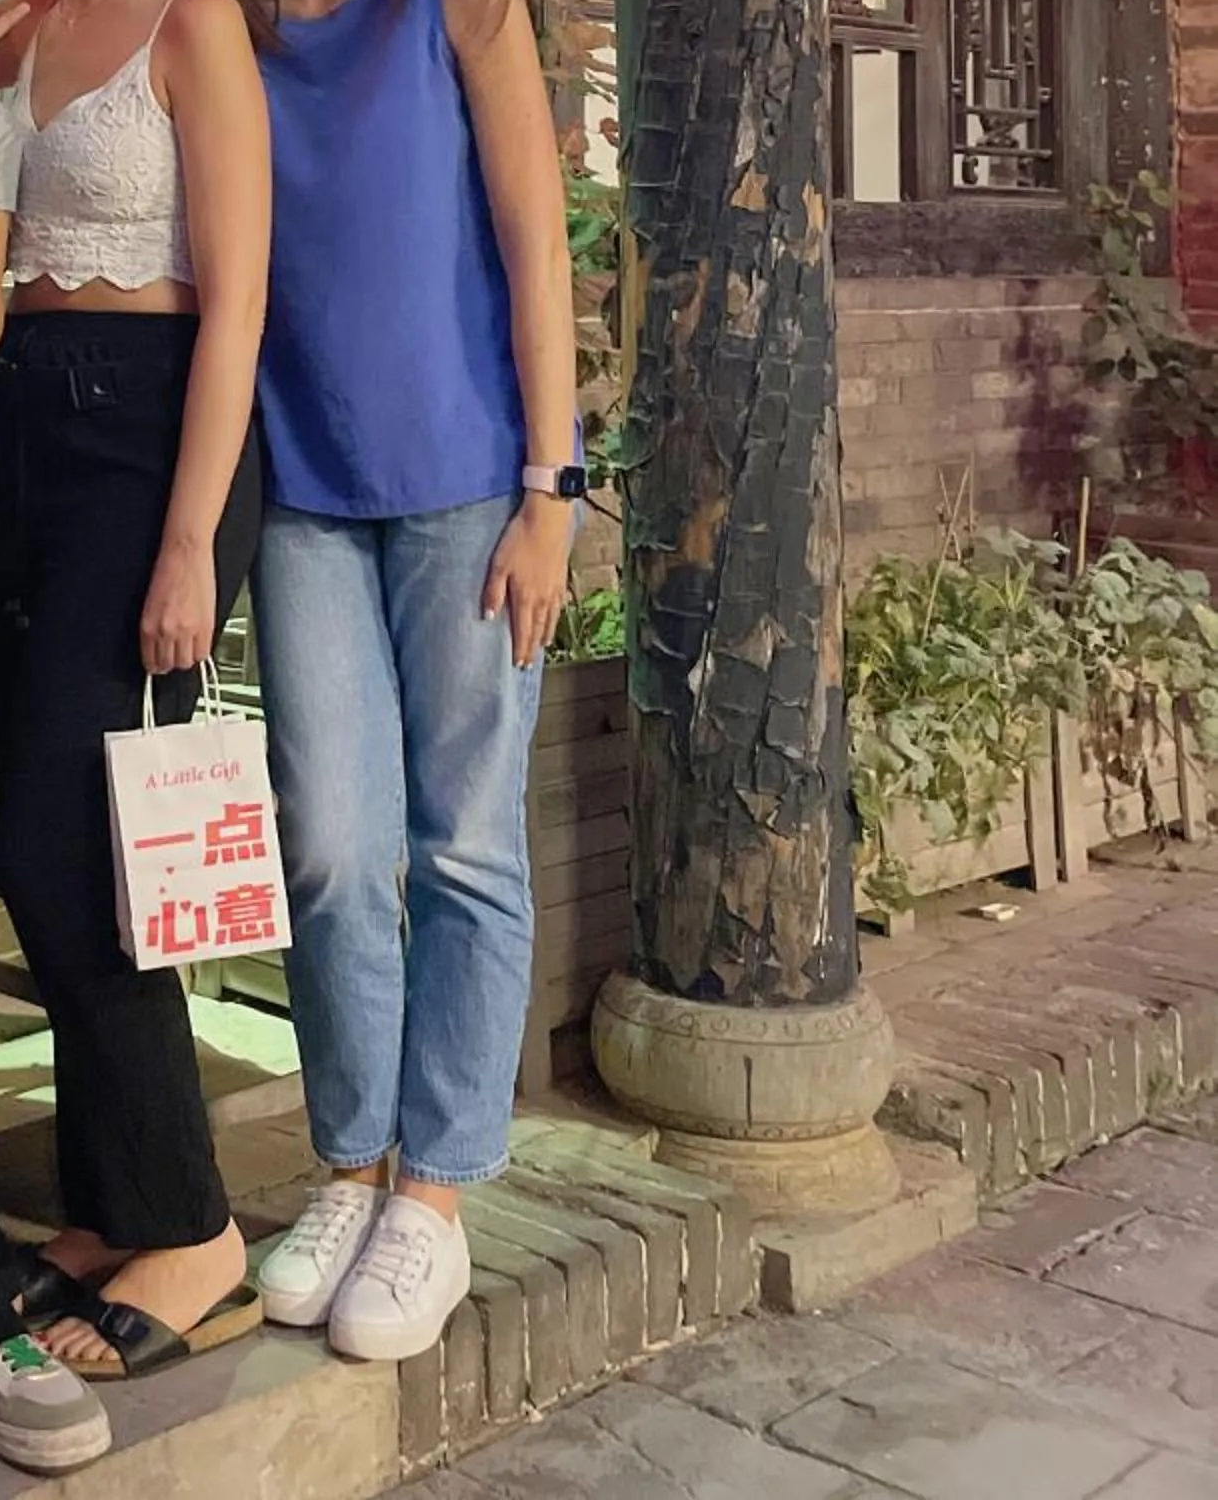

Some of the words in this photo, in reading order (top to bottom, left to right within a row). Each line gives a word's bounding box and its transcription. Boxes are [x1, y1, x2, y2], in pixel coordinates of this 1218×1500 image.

[145, 771, 157, 789] A
[163, 765, 205, 787] Little
[210, 761, 241, 783] Gift
[134, 803, 267, 866] 一点
[145, 883, 276, 955] 心意
